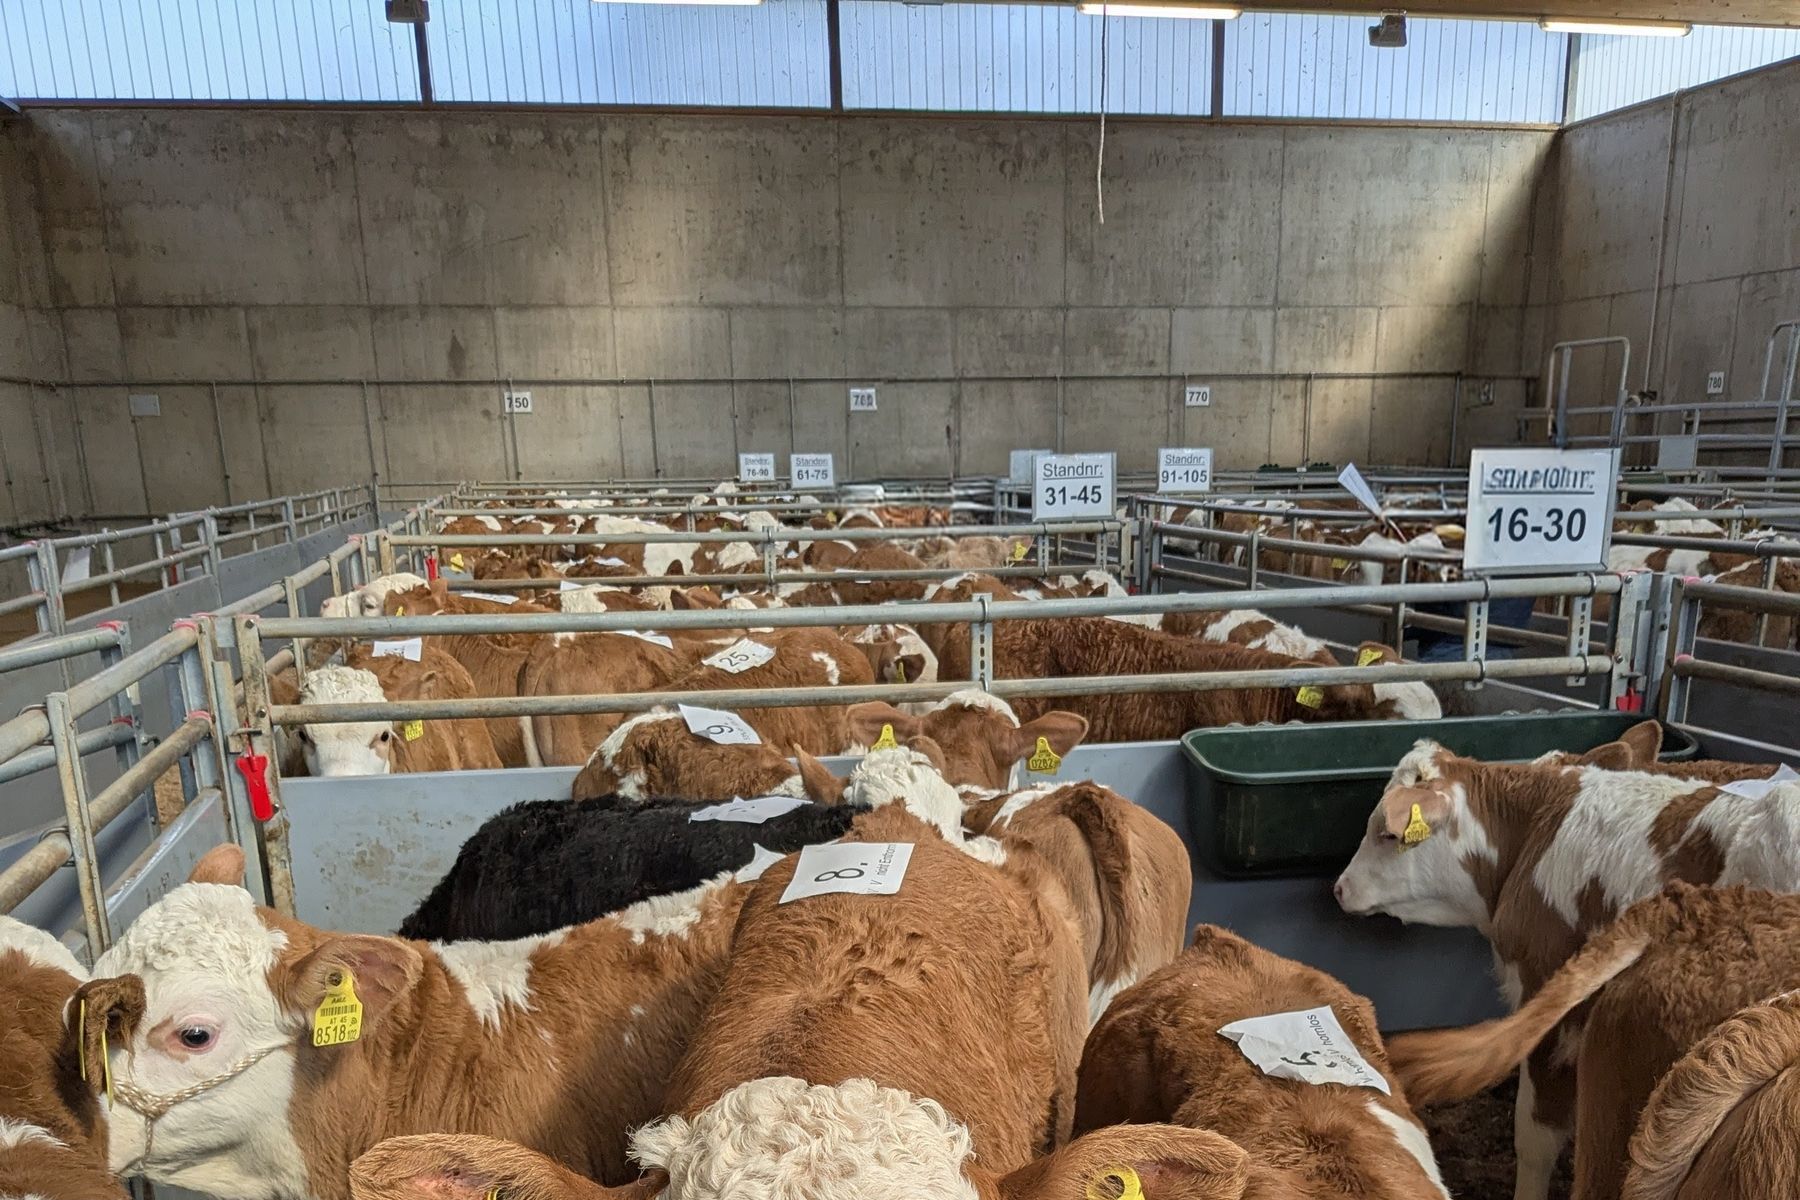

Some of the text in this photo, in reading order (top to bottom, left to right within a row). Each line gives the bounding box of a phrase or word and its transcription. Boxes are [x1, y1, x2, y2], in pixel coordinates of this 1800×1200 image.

[506, 397, 529, 408] 750
[1188, 391, 1208, 402] 770
[1165, 454, 1205, 465] Standnr:
[797, 469, 828, 480] 61-75
[1043, 463, 1103, 478] Standnr:
[1161, 470, 1207, 483] 91-105
[1045, 485, 1102, 505] 31-45
[1488, 507, 1587, 542] 16-30
[316, 1025, 347, 1044] 8518
